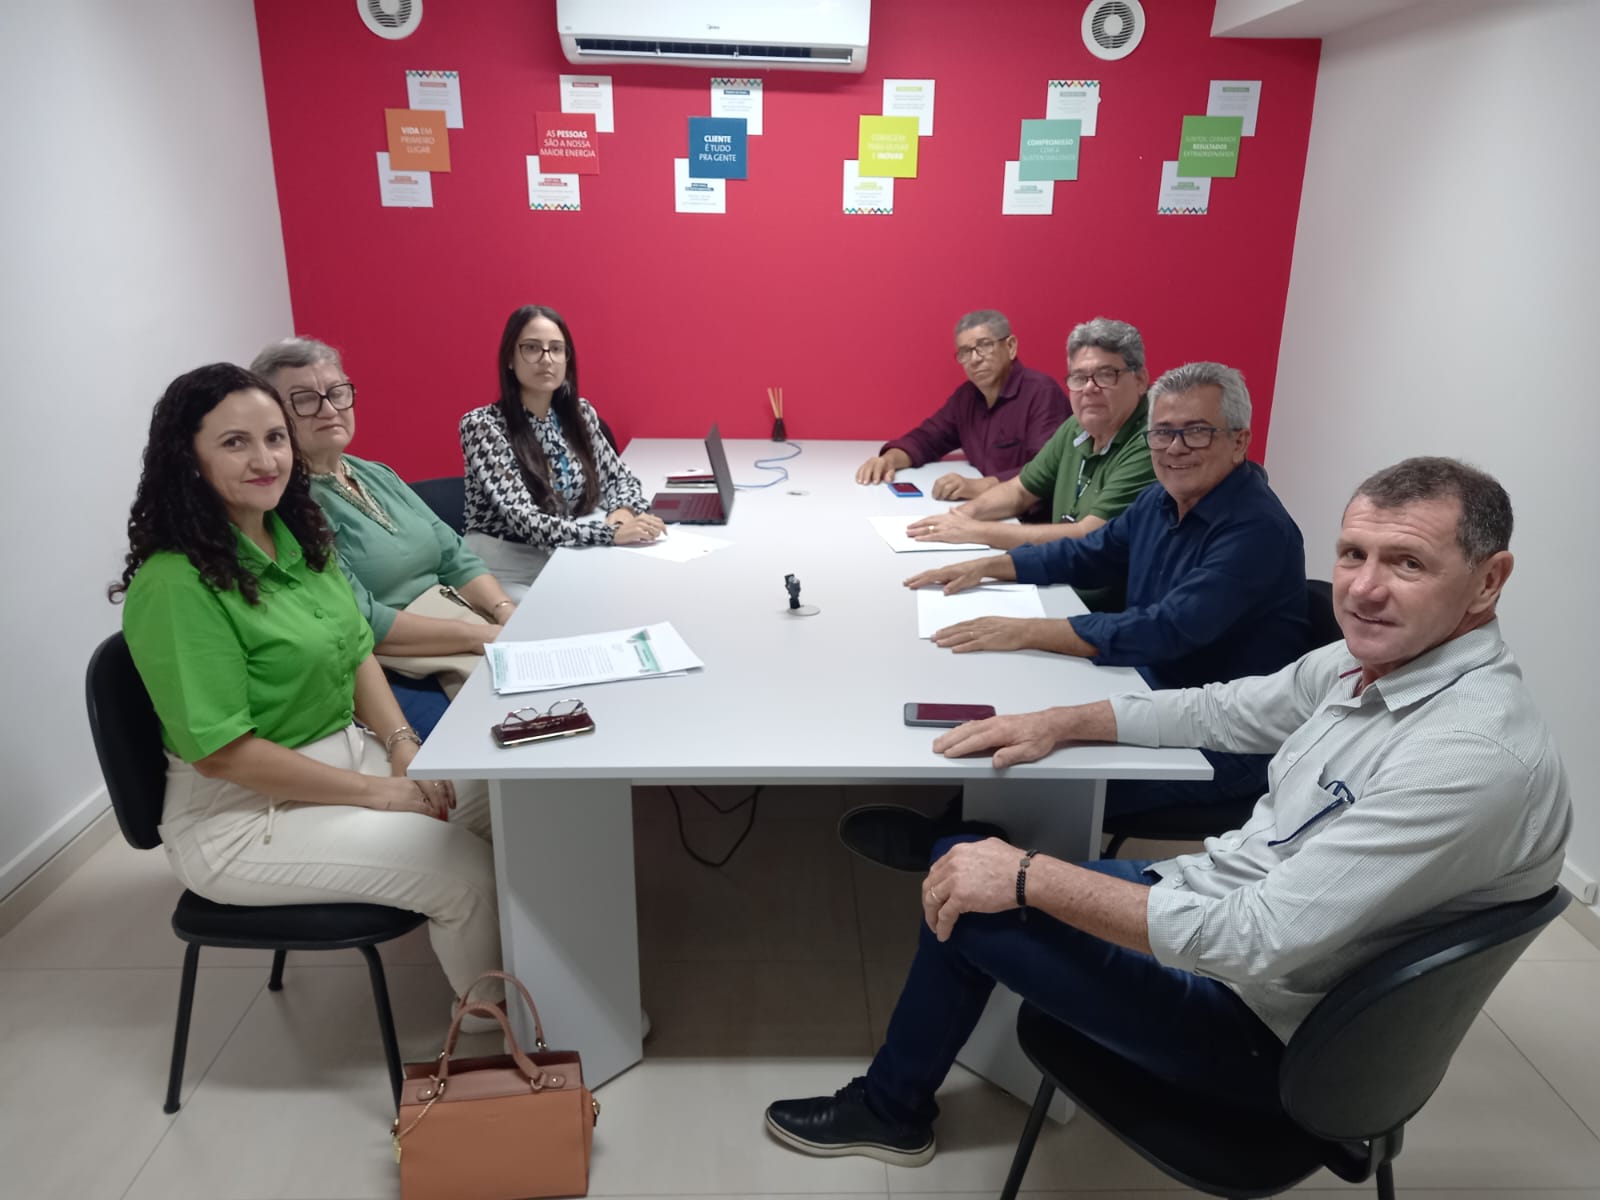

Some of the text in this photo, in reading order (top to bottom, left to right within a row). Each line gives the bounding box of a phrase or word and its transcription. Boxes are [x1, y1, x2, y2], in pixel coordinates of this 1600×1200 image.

[400, 127, 420, 135] VIDA
[546, 130, 588, 139] AS PESSOAS
[544, 138, 559, 147] SÃO
[566, 140, 591, 148] NOSSA
[703, 135, 732, 143] CLIENTE
[710, 144, 732, 152] TUDO
[540, 148, 596, 158] MAIOR ENERGIA
[699, 153, 737, 162] PRA GENTE
